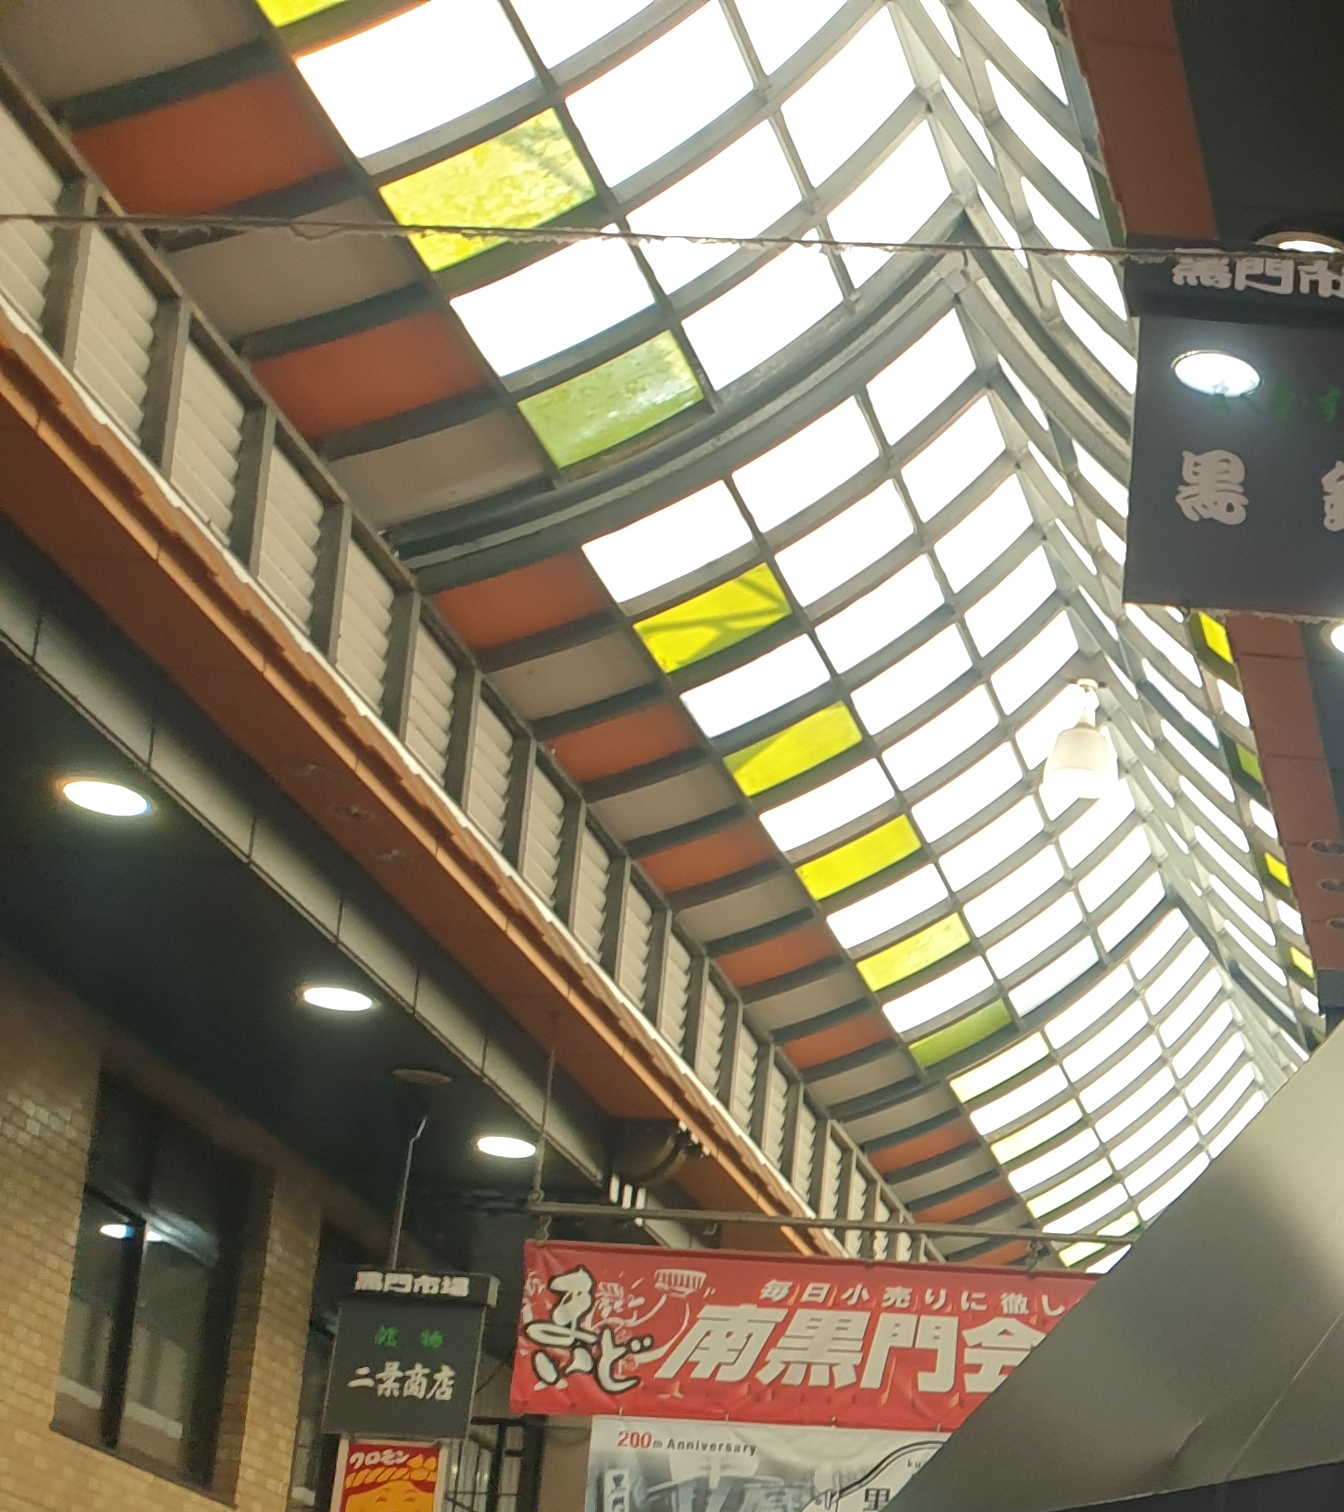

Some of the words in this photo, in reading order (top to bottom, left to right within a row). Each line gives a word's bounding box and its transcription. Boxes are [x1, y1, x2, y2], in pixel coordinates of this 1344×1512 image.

[654, 1304, 1048, 1395] 南黒門会
[348, 1361, 456, 1401] 二葉商店
[667, 1438, 757, 1456] Anniversary
